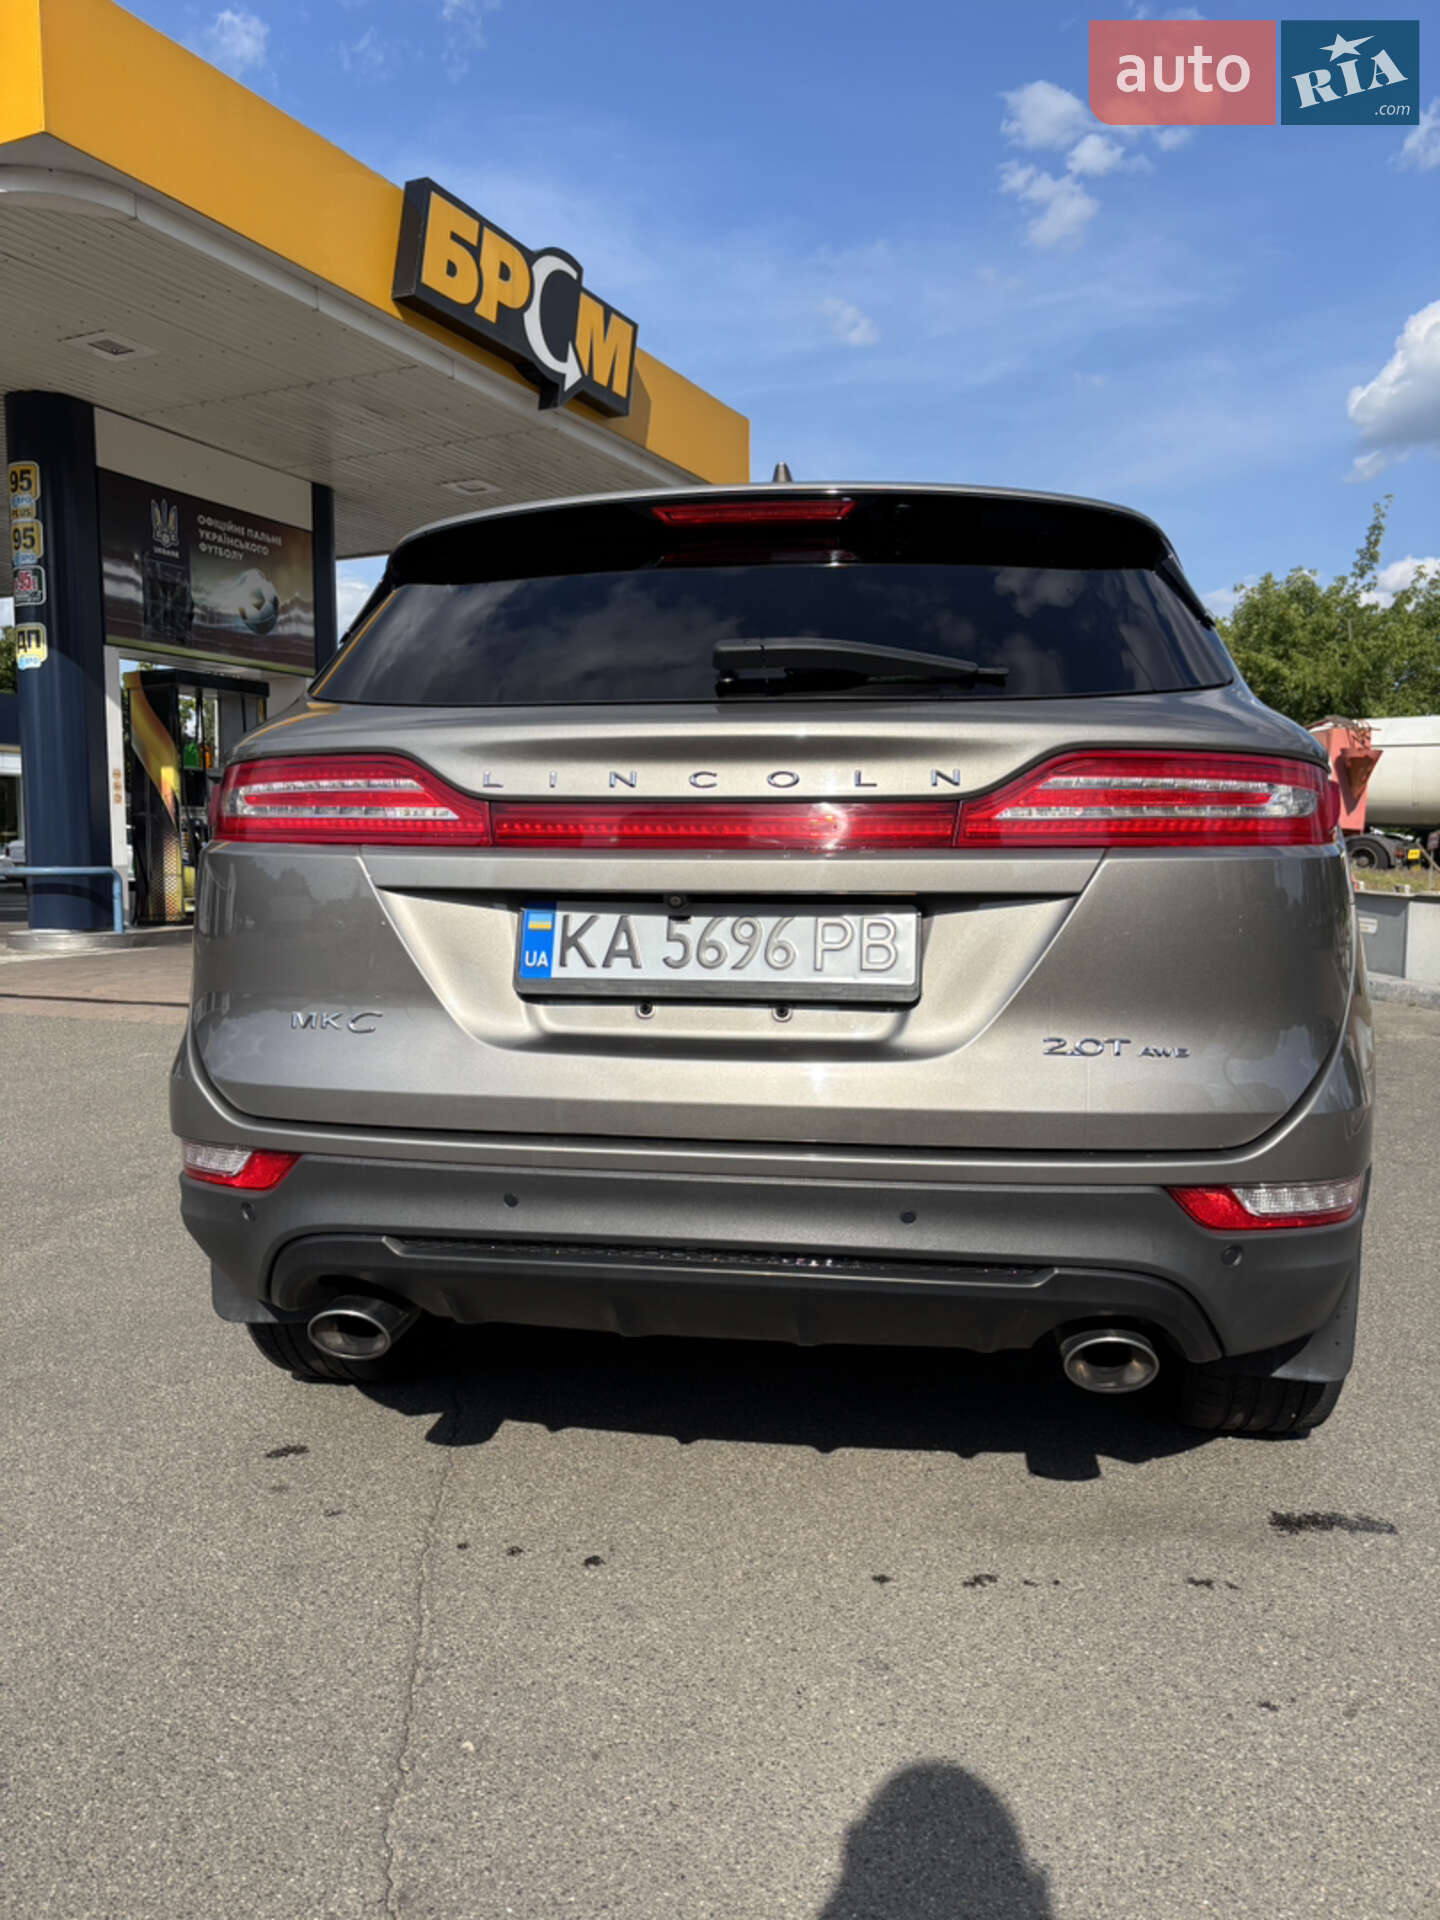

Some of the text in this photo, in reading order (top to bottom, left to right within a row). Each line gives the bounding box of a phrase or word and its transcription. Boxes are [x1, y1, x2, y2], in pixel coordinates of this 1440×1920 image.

[421, 190, 635, 399] БРСМ
[10, 469, 33, 493] 95
[12, 527, 36, 550] 95
[17, 629, 41, 653] ДП
[482, 768, 962, 789] LINCOLN
[559, 914, 899, 972] KA 5696 PB
[525, 951, 549, 968] UA
[290, 1011, 384, 1034] MKC
[1042, 1037, 1132, 1057] 2.0T
